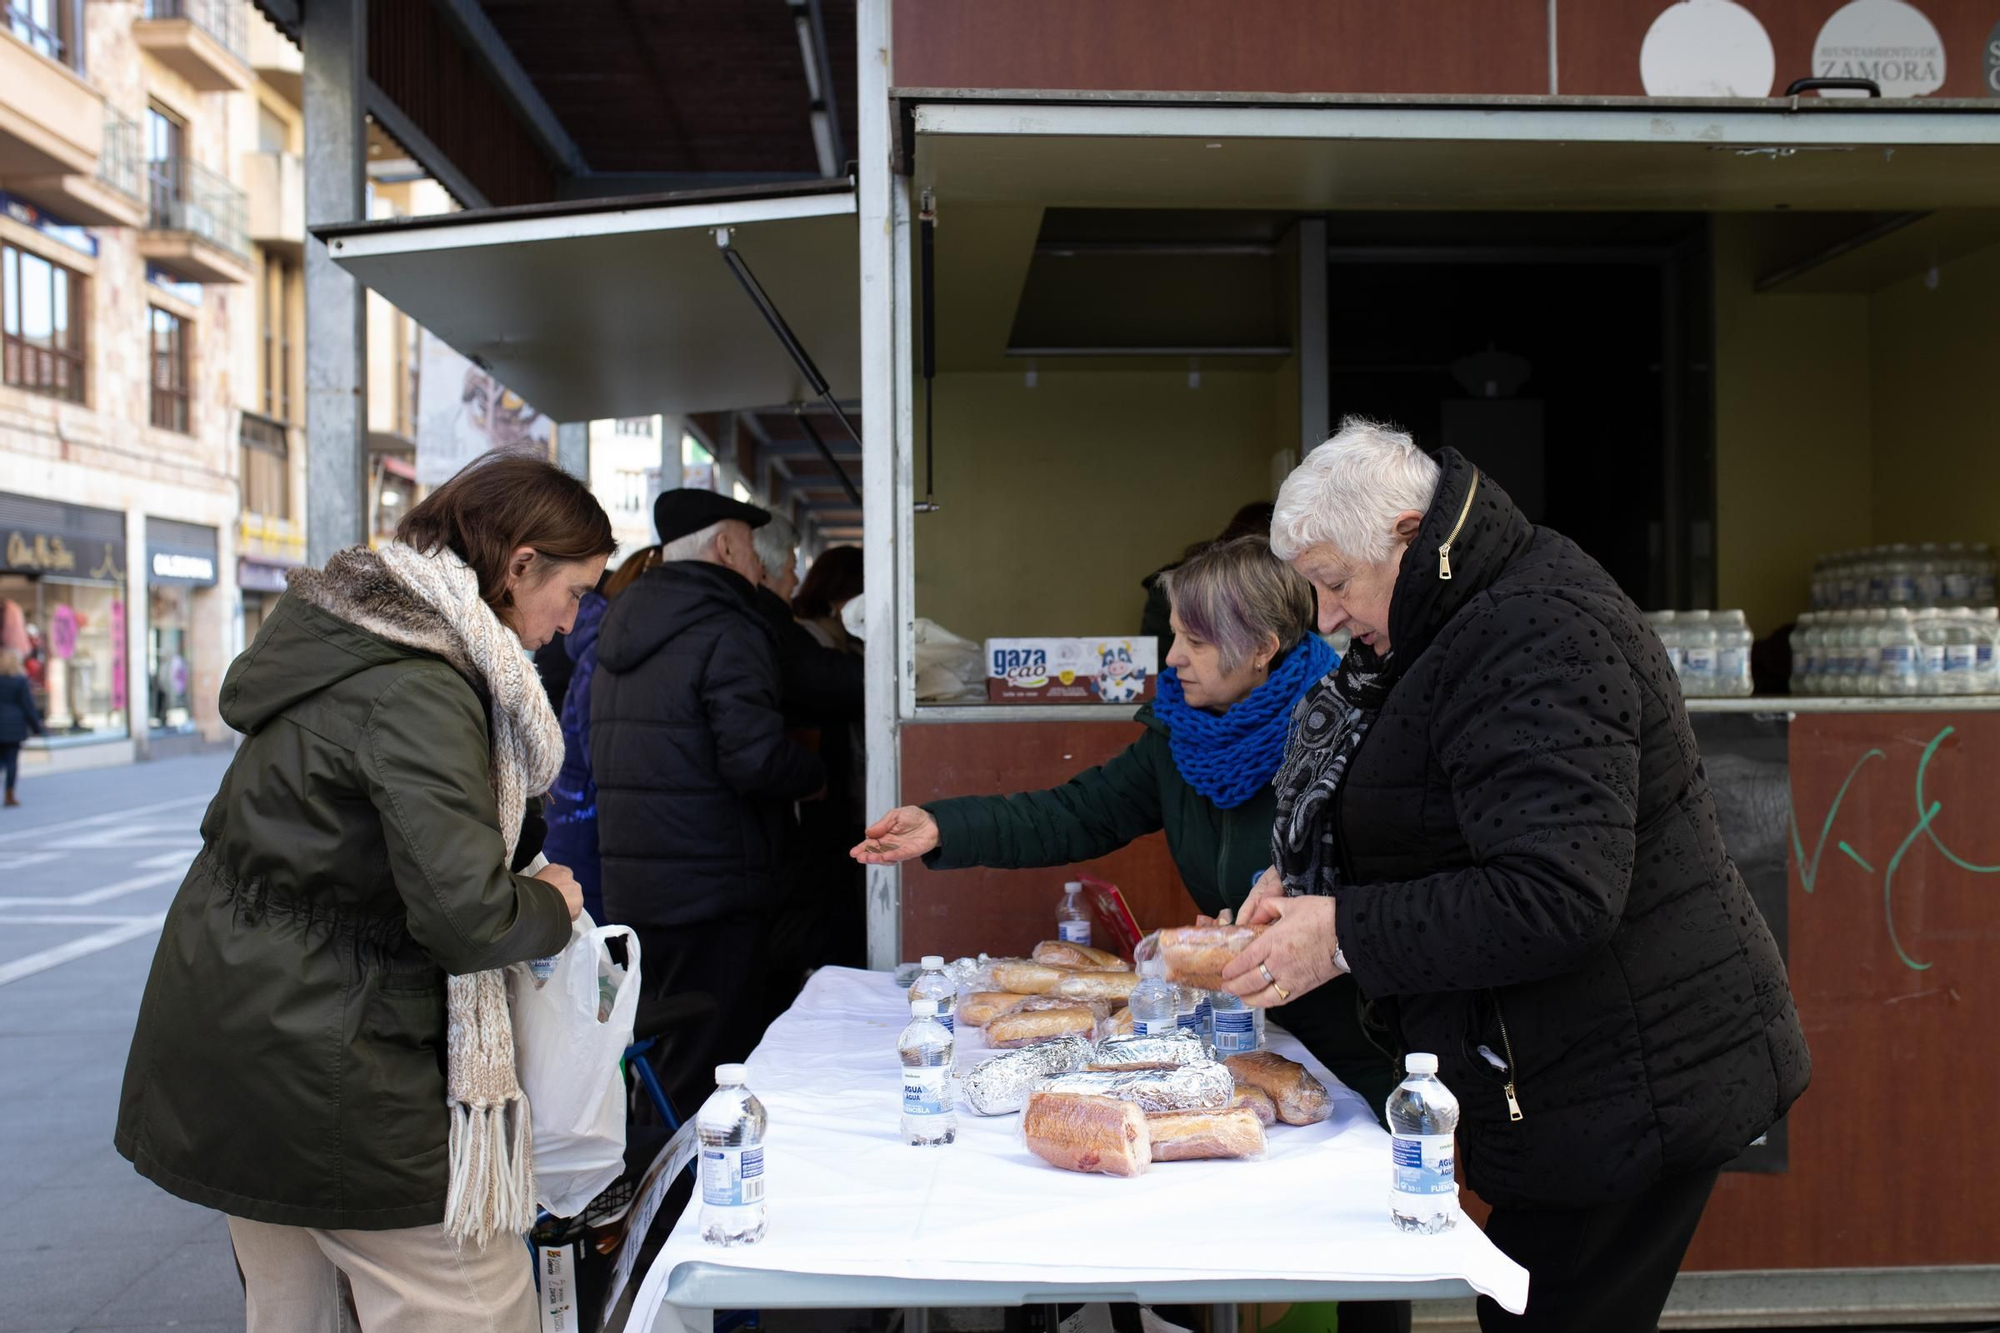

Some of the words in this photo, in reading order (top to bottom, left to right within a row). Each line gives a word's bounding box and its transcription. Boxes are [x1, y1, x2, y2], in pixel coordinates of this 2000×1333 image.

[1819, 46, 1918, 58] AYUNTAMIENTO
[1819, 60, 1938, 82] ZAMORA
[994, 649, 1046, 676] gaza
[1007, 665, 1047, 678] cao
